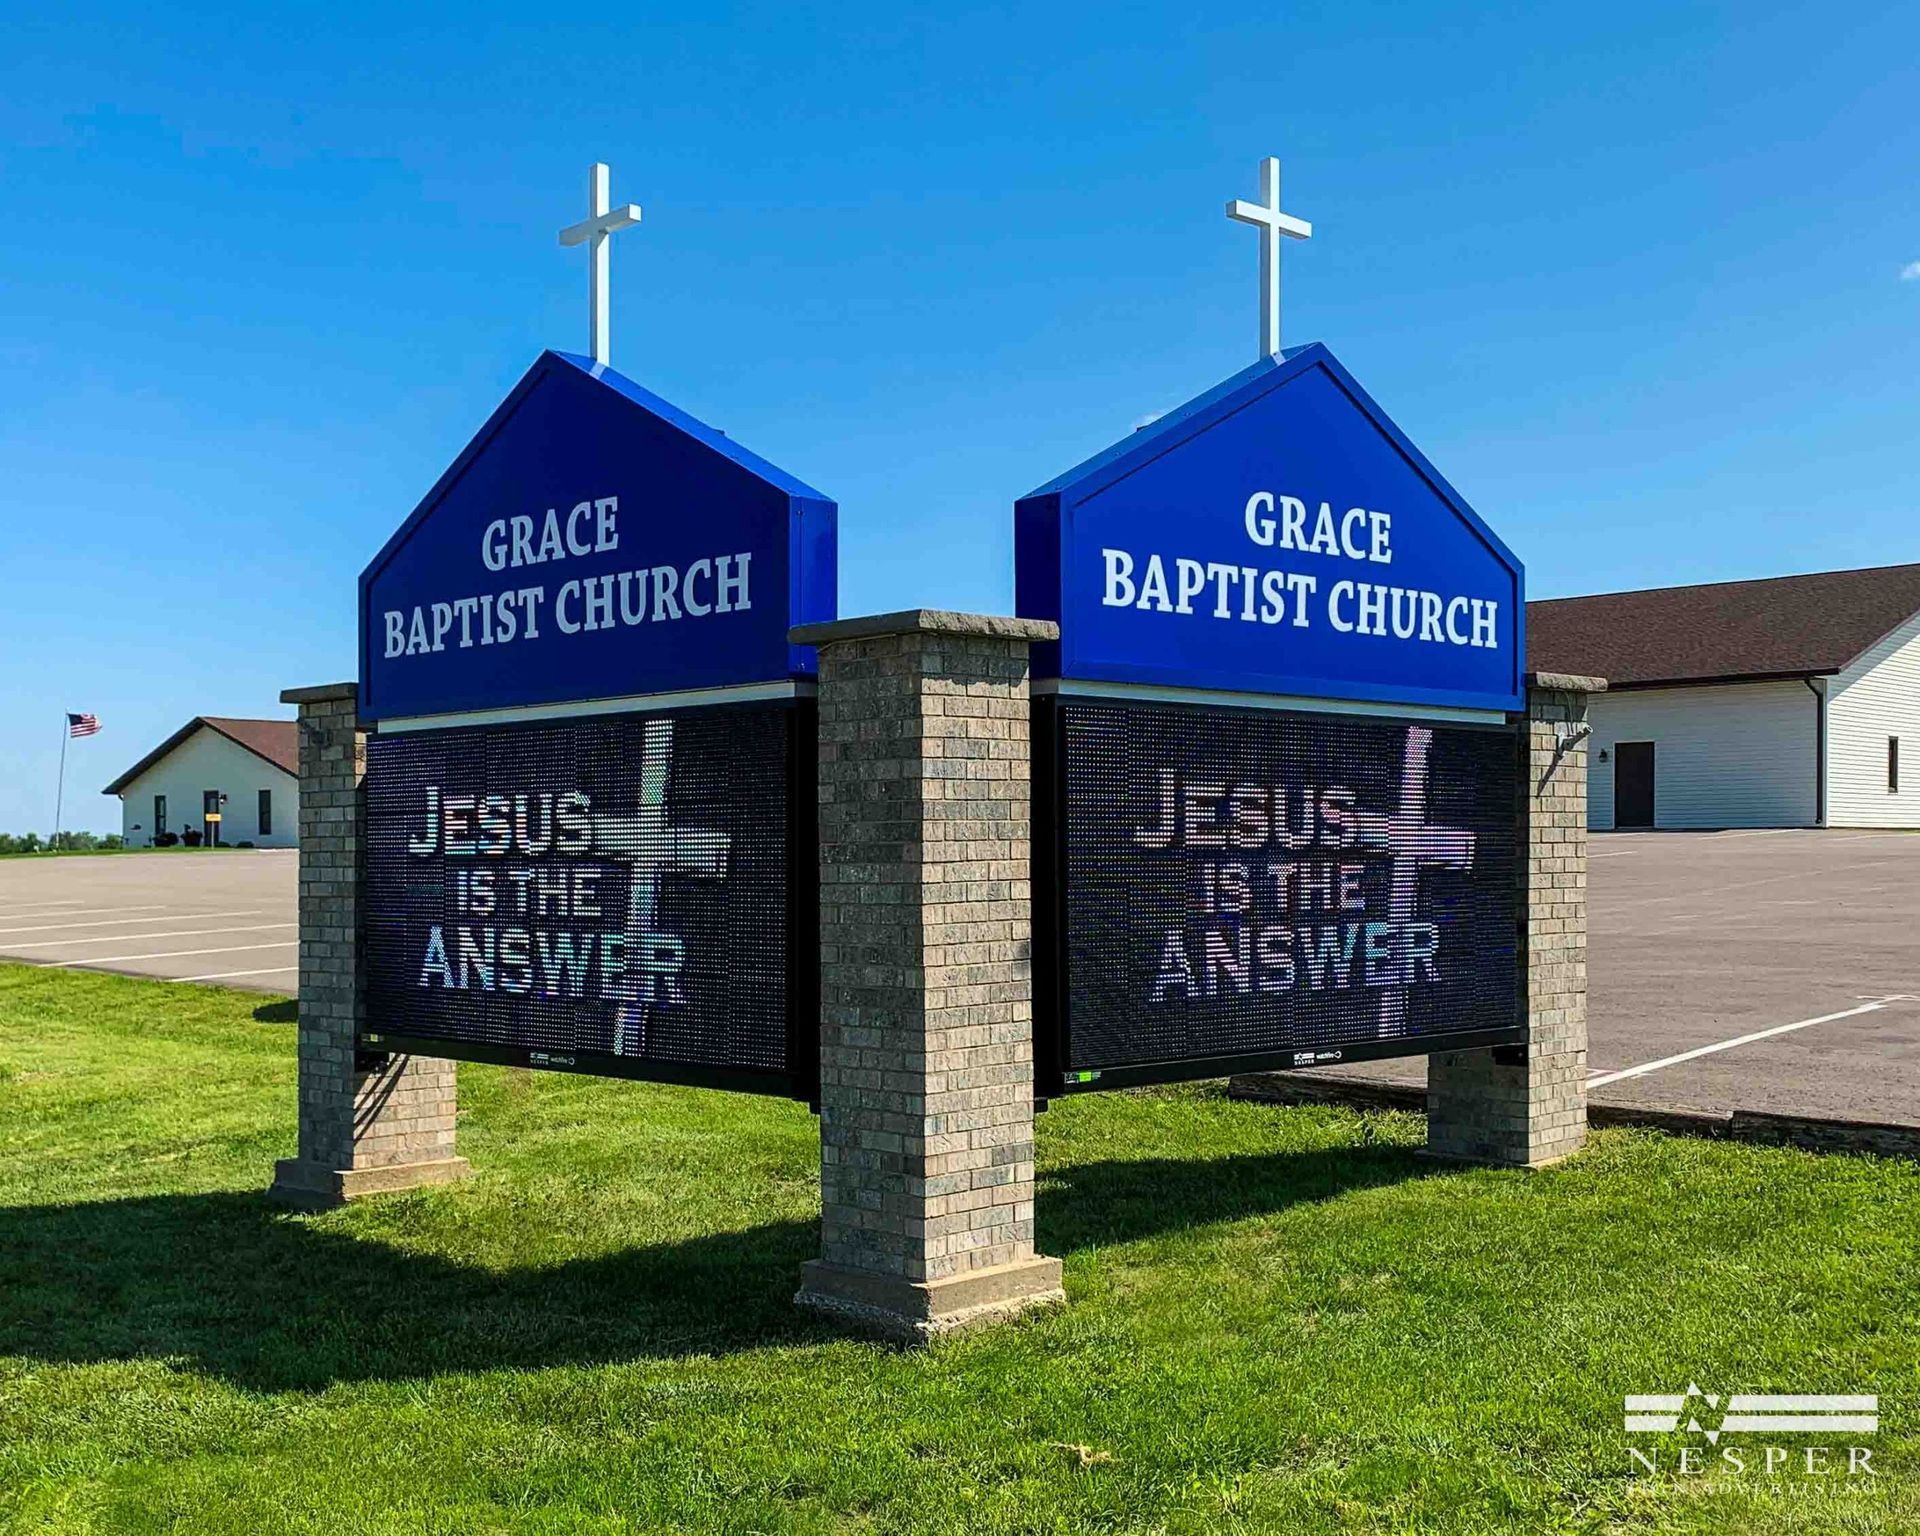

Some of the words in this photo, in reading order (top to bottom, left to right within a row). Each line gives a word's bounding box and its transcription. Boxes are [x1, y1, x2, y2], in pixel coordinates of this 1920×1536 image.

[482, 495, 619, 572] GRACE
[1244, 490, 1392, 565] GRACE
[384, 585, 544, 659] BAPTIST
[555, 552, 752, 634] CHURCH
[1102, 548, 1317, 628] BAPTIST
[1328, 579, 1498, 649] CHURCH
[408, 786, 591, 855] JESUS
[1133, 768, 1356, 849] JESUS
[458, 870, 496, 915] IS
[509, 868, 601, 917] THE
[1204, 862, 1251, 913] IS
[1267, 861, 1366, 911] THE
[416, 926, 687, 1003] ANSWER
[1149, 921, 1442, 1002] ANSWER
